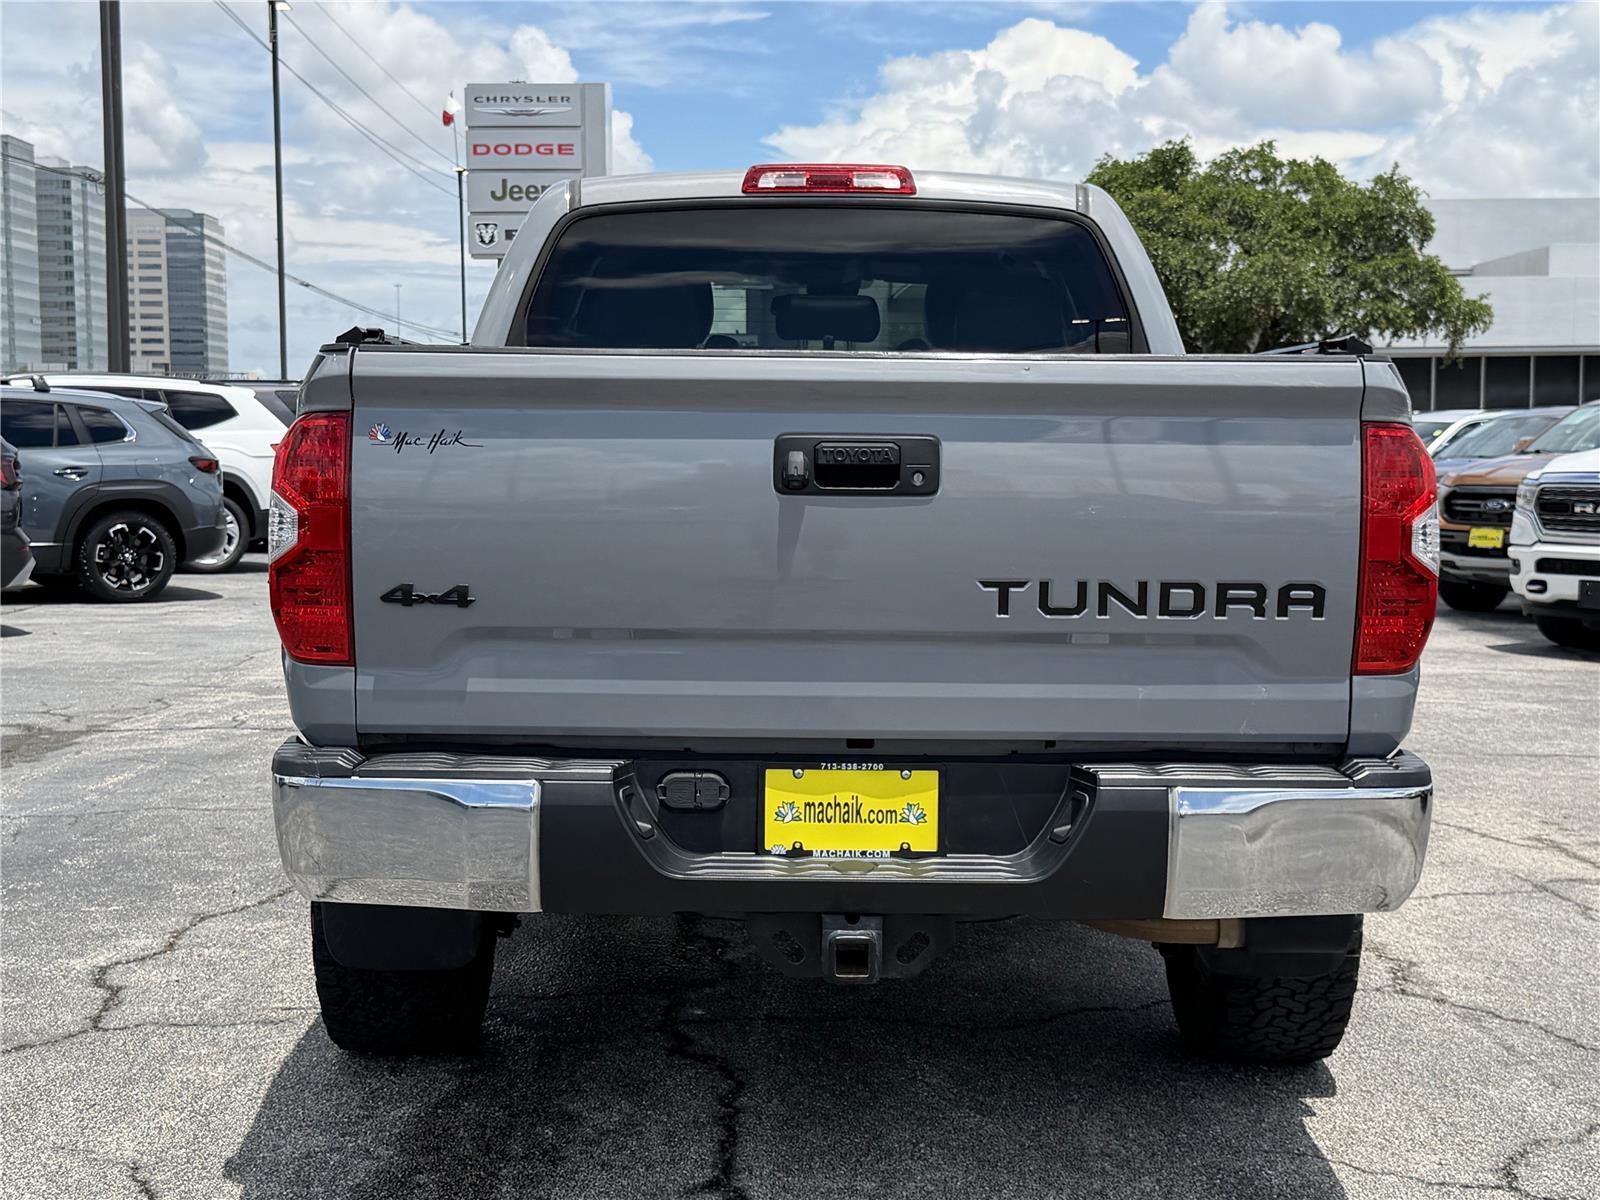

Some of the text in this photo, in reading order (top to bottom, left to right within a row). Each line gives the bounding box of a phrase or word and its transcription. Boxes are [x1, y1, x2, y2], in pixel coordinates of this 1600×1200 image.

[473, 95, 571, 103] CHRYSLER
[472, 143, 575, 156] DODGE
[490, 178, 551, 202] Jee
[822, 448, 895, 463] TOYOTA
[975, 580, 1327, 621] TUNDRA
[803, 795, 898, 825] machaik.com
[812, 850, 891, 859] MACHAIK.COM
